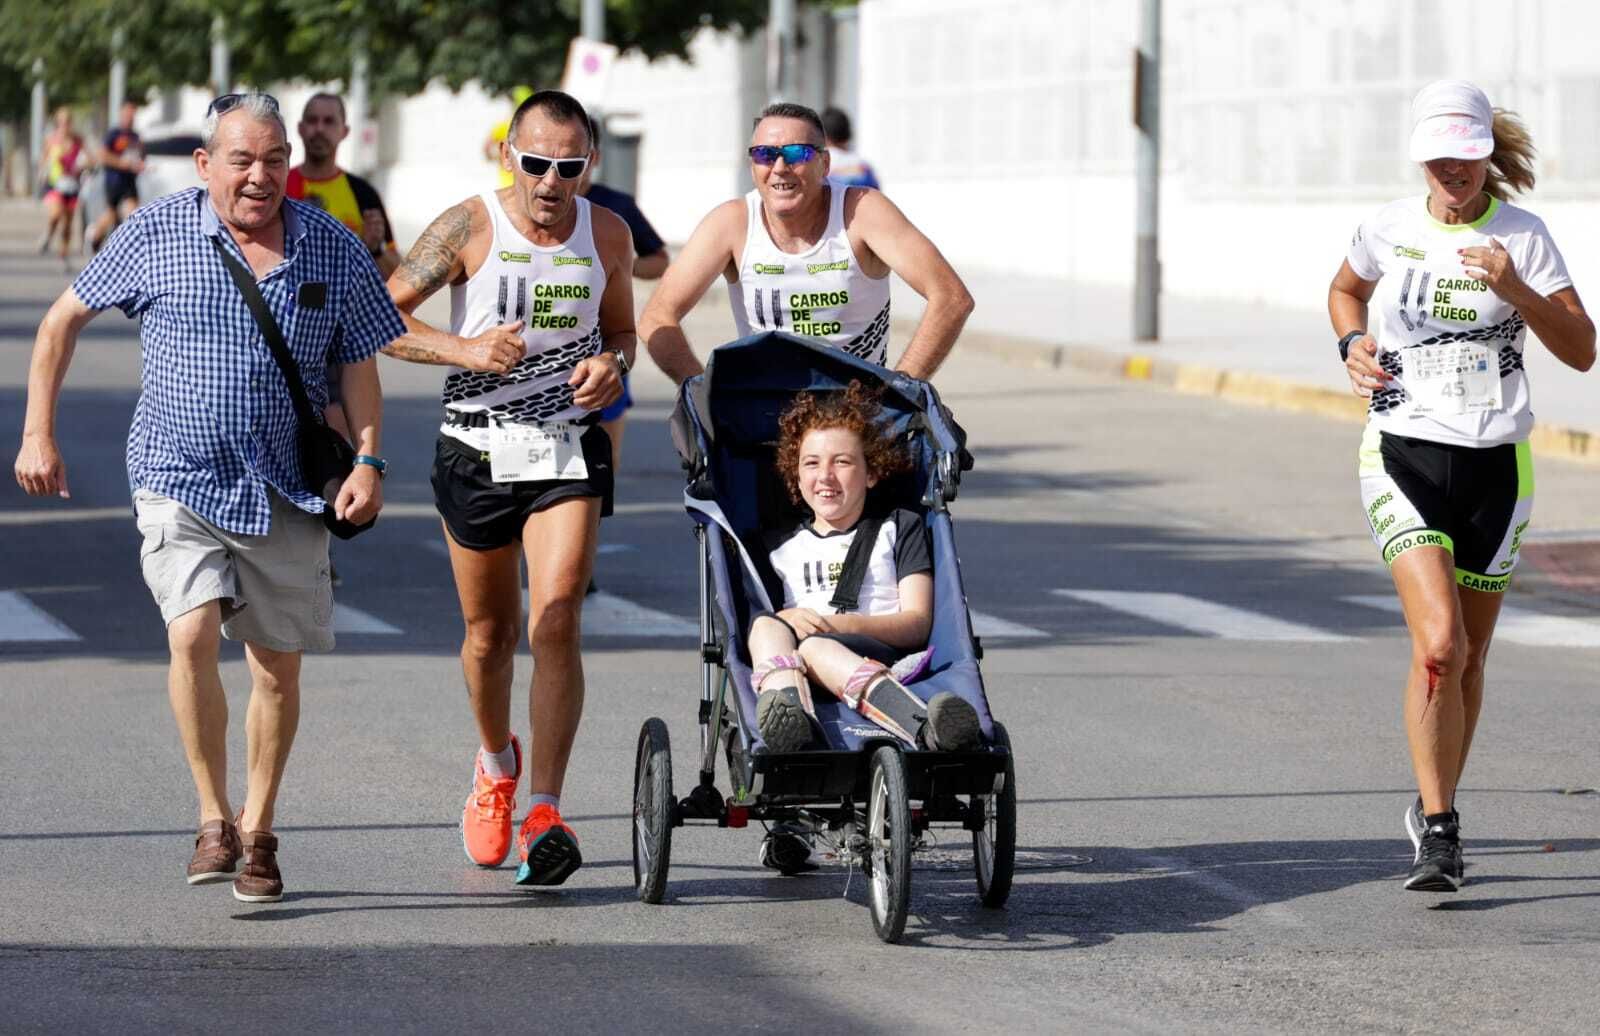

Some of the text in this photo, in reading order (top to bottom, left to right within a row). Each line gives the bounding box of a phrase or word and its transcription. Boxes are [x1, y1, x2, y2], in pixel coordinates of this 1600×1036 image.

[534, 284, 590, 299] CARROS
[1437, 279, 1488, 292] CARROS
[790, 290, 849, 307] CARROS
[1434, 291, 1451, 304] DE
[533, 300, 552, 313] DE
[1432, 306, 1477, 321] FUEGO
[531, 315, 578, 328] FUEGO
[791, 309, 810, 321] DE
[793, 321, 841, 336] FUEGO
[1441, 382, 1466, 397] 45
[527, 447, 553, 464] 54
